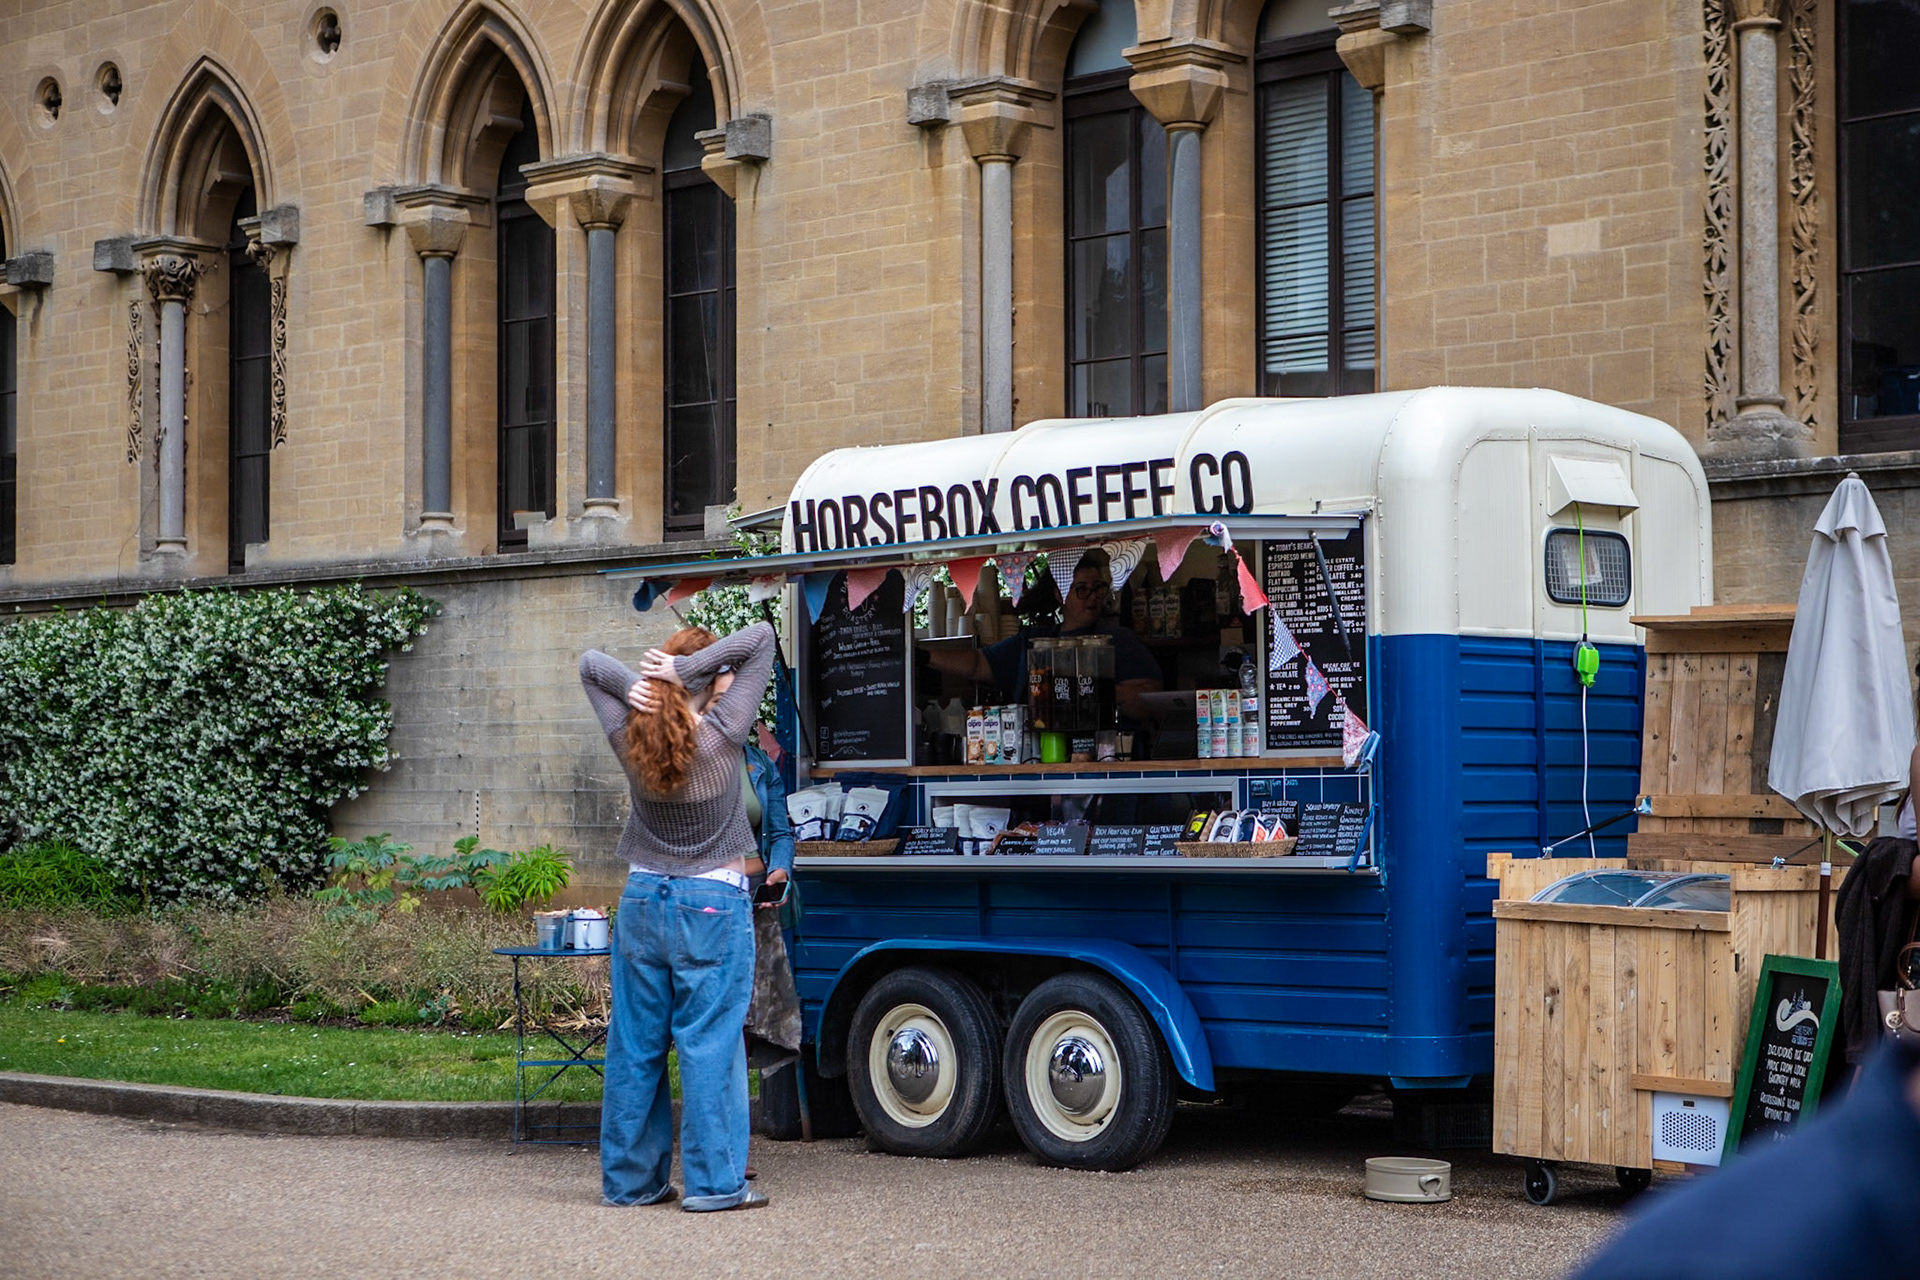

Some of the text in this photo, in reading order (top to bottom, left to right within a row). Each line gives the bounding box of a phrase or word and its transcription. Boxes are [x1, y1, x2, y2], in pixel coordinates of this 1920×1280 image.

[791, 451, 1254, 553] HORSEBOX COFFEE CO
[1276, 542, 1314, 551] TODAY'S BEANS
[1274, 552, 1316, 562] ESPRESSO MENU
[1268, 562, 1294, 570] ESPRESSO
[1334, 564, 1354, 572] COFFEE
[1268, 578, 1281, 586] FLAT
[1268, 585, 1298, 594] CAPPUCCINO
[1270, 670, 1298, 678] CHOCOLATE
[1276, 683, 1286, 691] TEA
[968, 720, 982, 728] alpro
[984, 720, 998, 728] alpro
[1046, 827, 1066, 836] VEGAN
[1150, 826, 1170, 834] GLUTEN
[1767, 1044, 1793, 1060] DELICIOUS
[1794, 1049, 1802, 1061] ICE
[1766, 1059, 1806, 1077] MADE FROM LOCAL
[1790, 1077, 1801, 1089] MILK
[1787, 1098, 1800, 1110] VEGAN
[1764, 1106, 1783, 1121] OPTIONS
